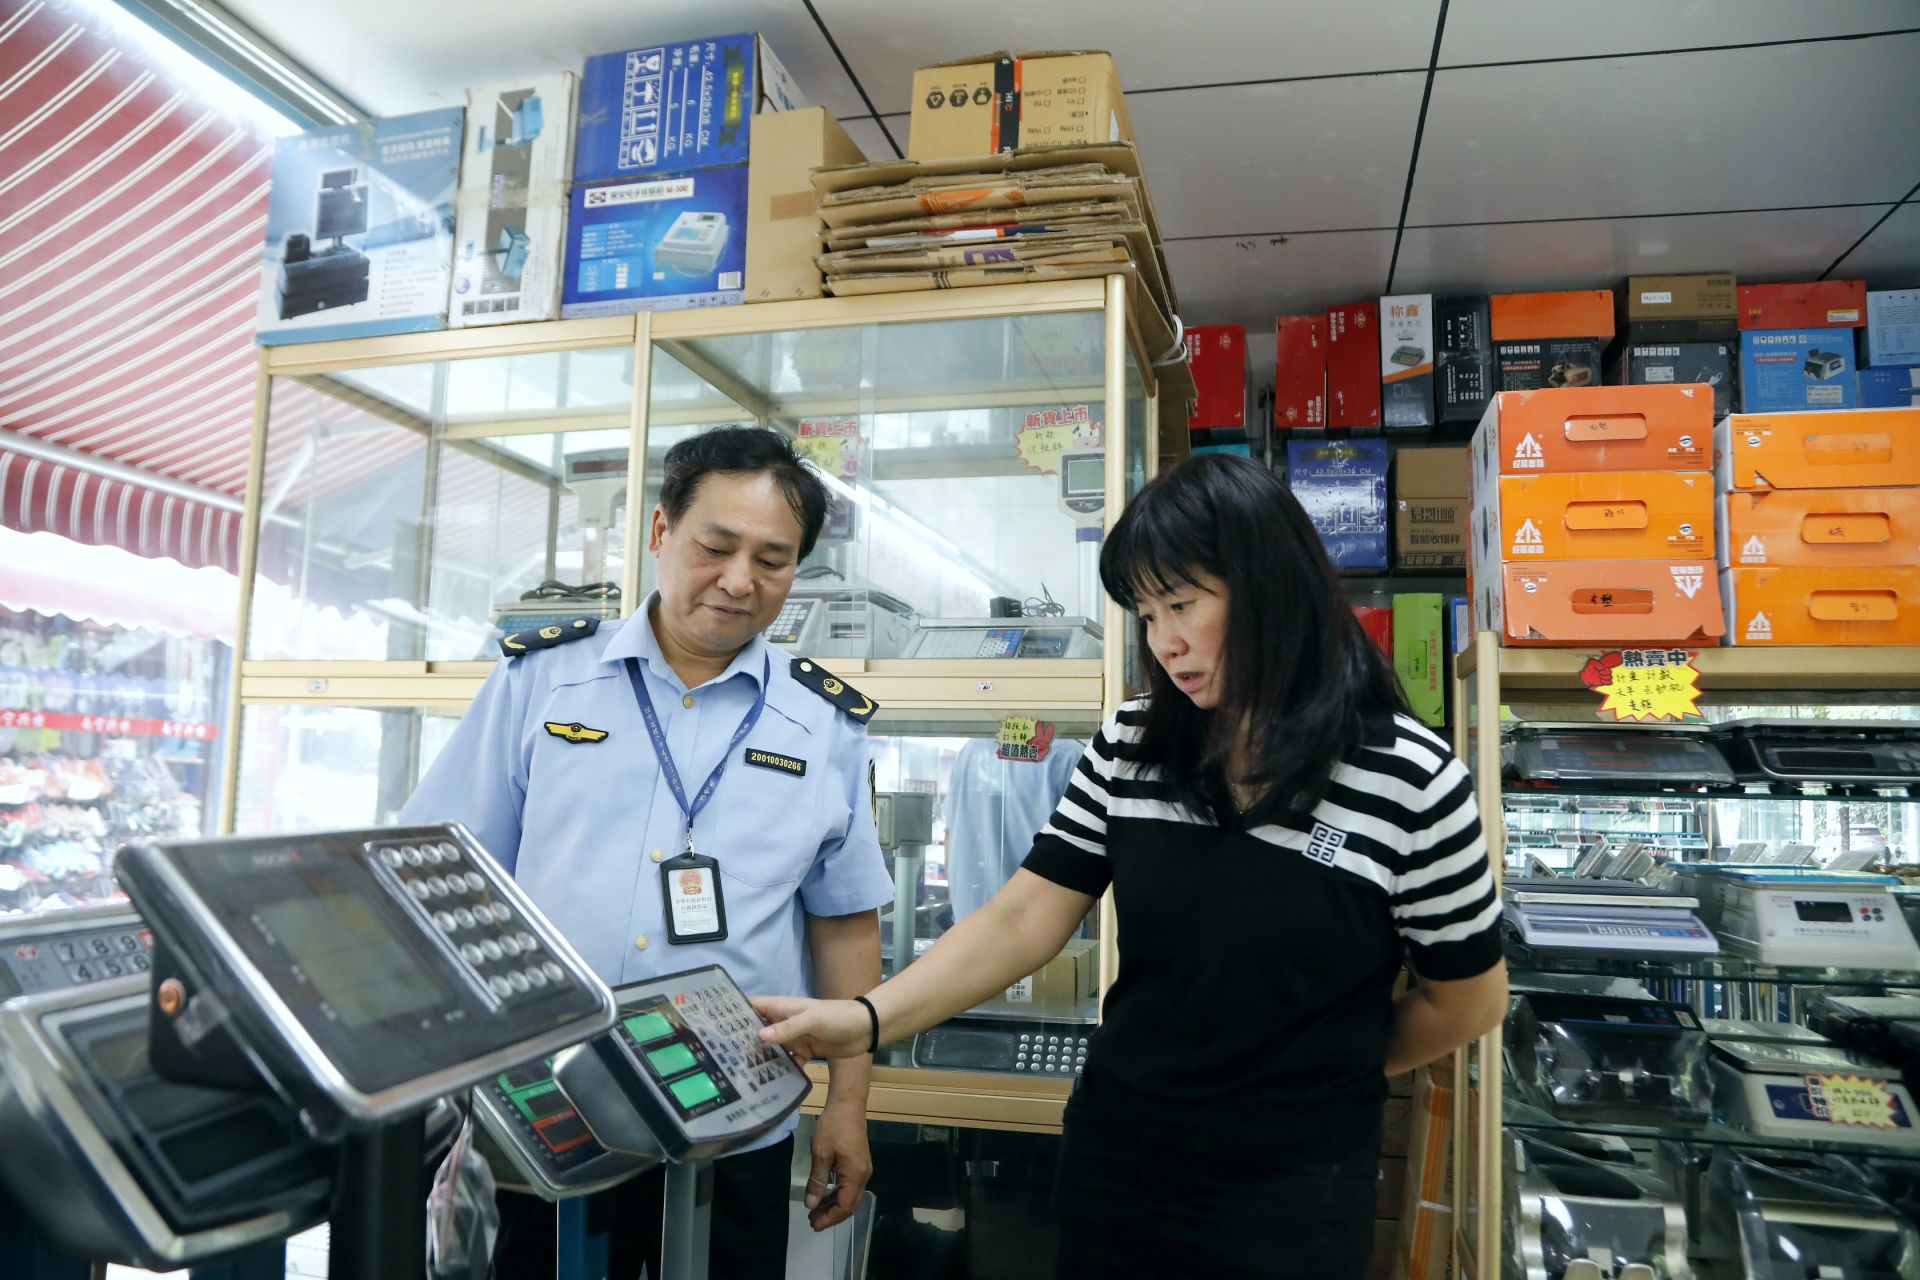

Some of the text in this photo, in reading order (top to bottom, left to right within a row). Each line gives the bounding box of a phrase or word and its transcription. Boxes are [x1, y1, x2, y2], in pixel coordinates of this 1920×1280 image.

[751, 752, 802, 772] 20010030266
[59, 942, 75, 959] 7
[91, 939, 109, 955] 8
[77, 962, 92, 980] 4
